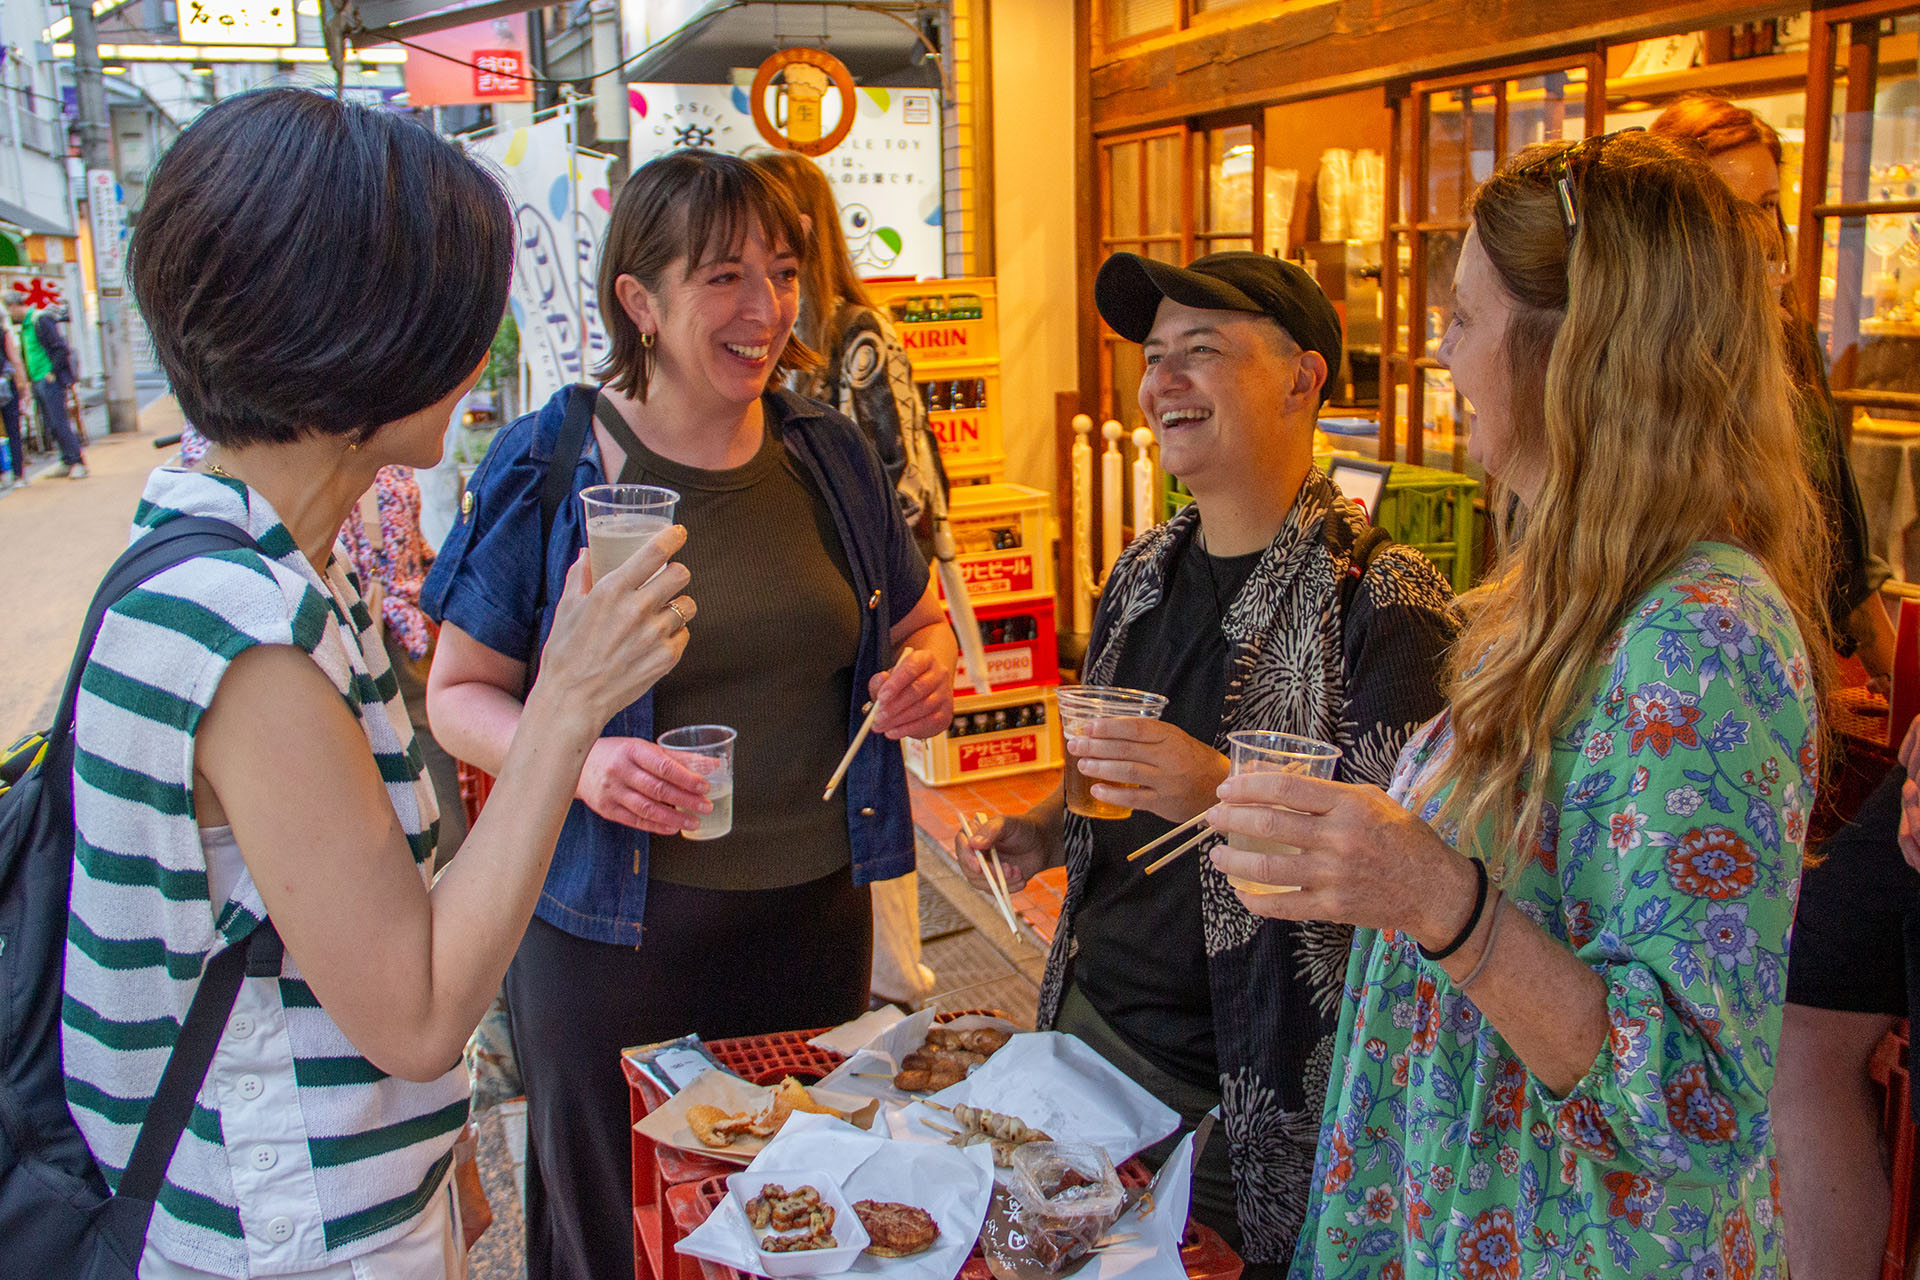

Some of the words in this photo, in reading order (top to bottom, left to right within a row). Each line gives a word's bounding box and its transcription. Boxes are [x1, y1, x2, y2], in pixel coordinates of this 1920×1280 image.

[797, 104, 813, 122] 生
[885, 139, 920, 150] TOY
[902, 327, 967, 349] KIRIN
[929, 418, 978, 443] RIN
[961, 558, 1030, 580] サヒビール
[987, 656, 1030, 673] PPORO
[961, 737, 1034, 759] アサヒビール
